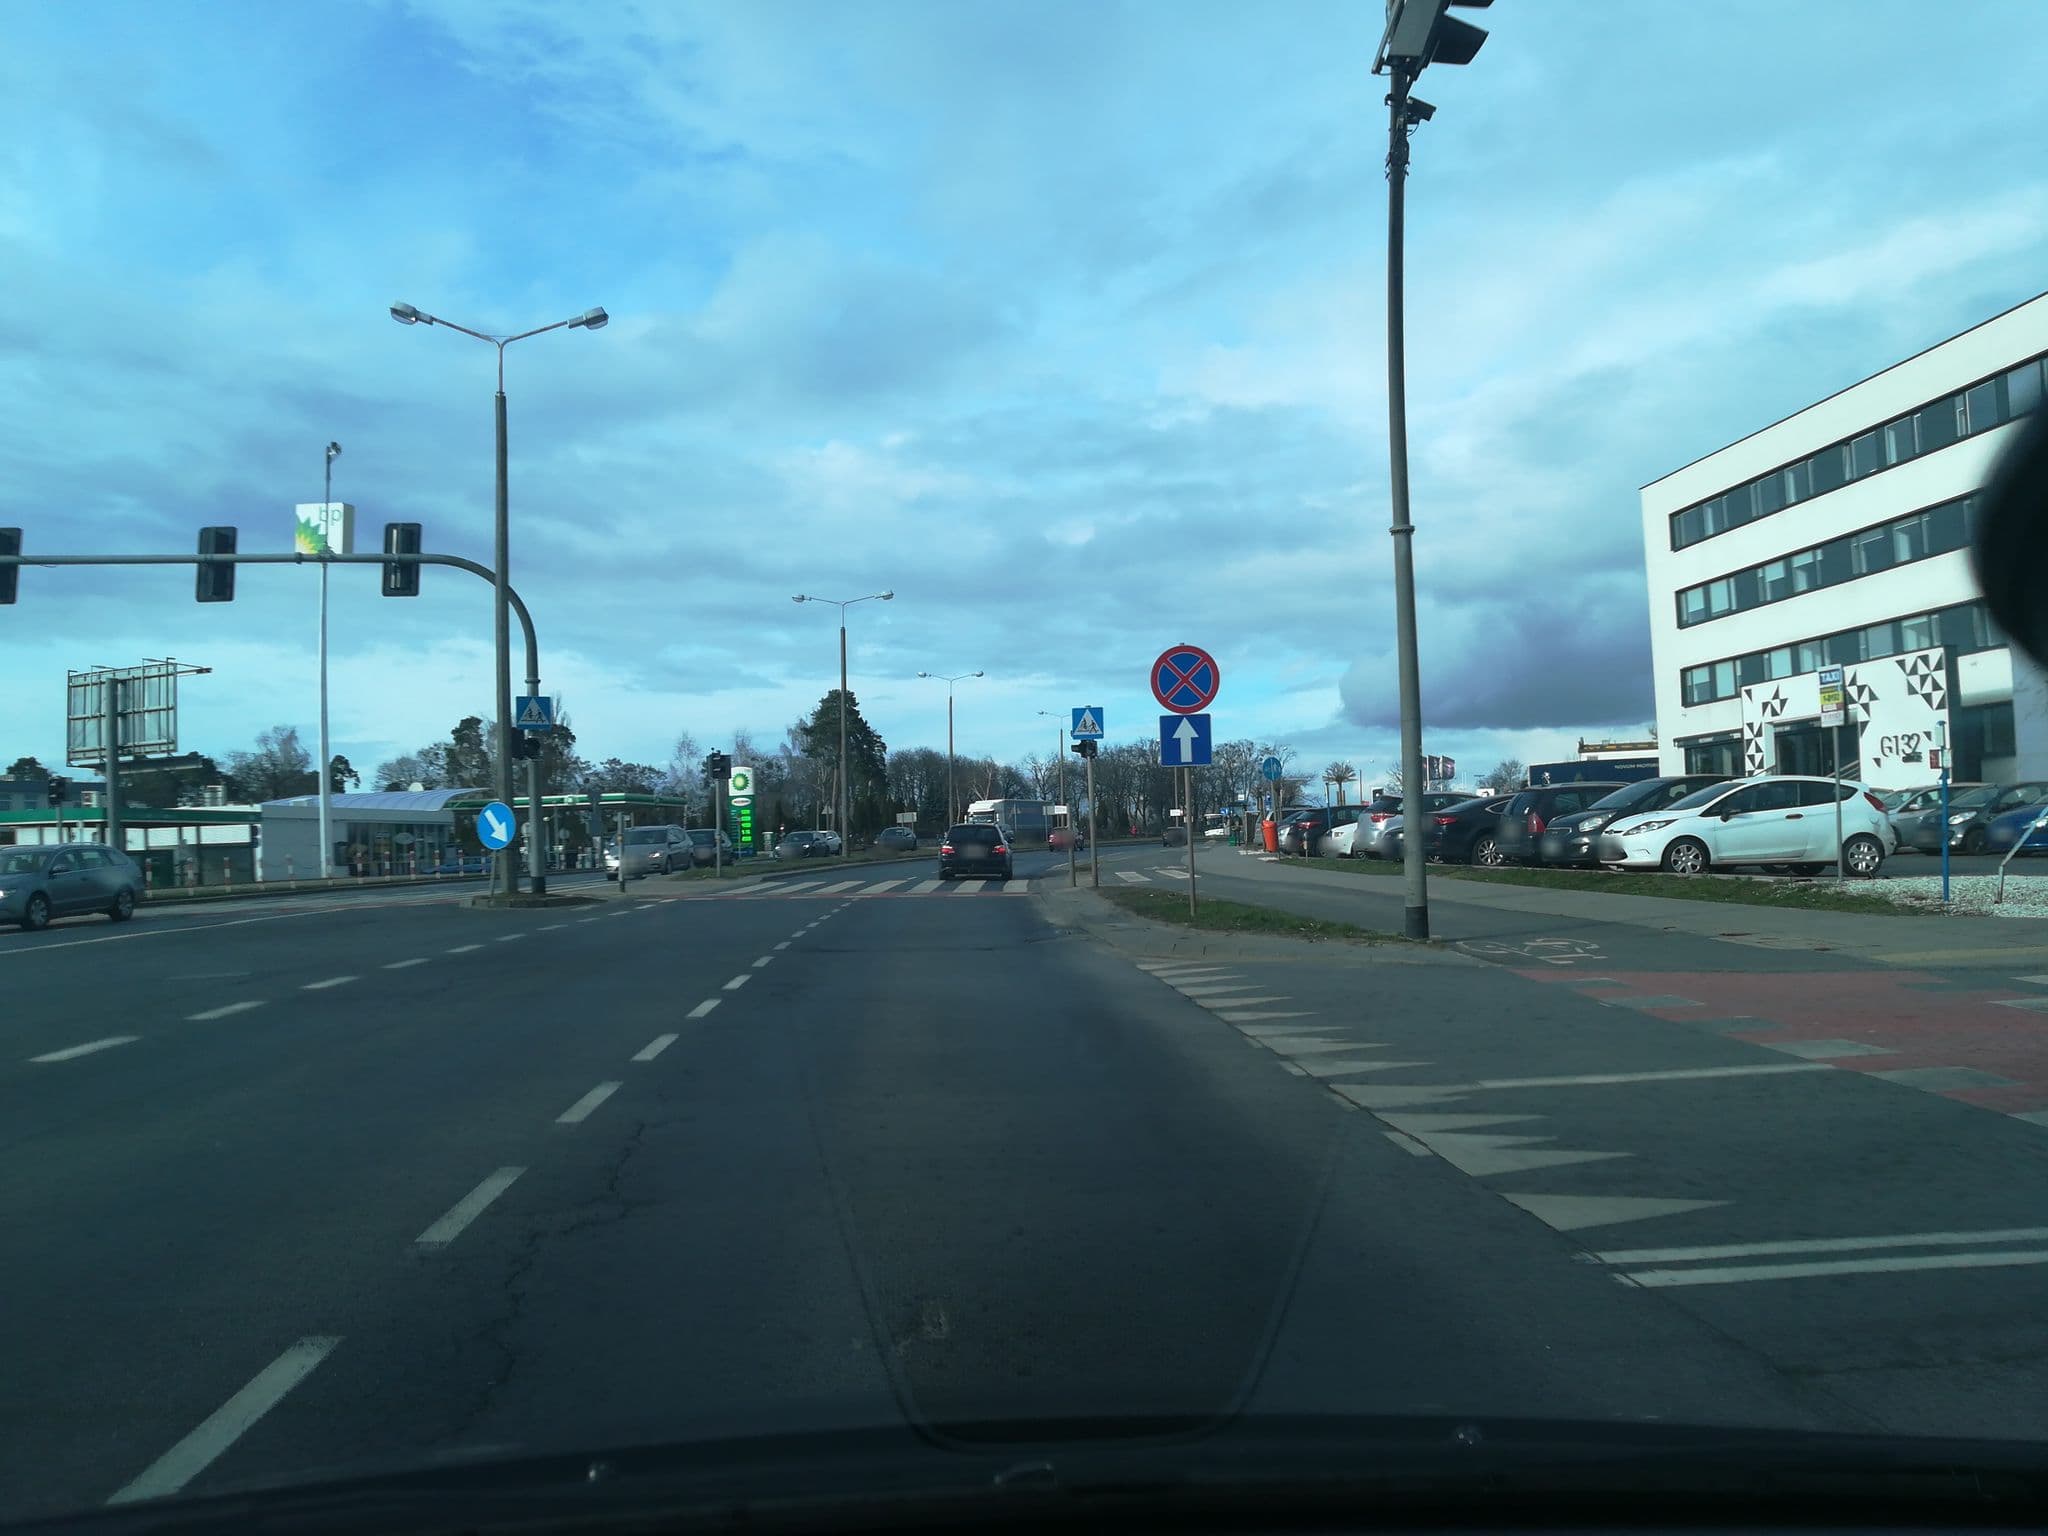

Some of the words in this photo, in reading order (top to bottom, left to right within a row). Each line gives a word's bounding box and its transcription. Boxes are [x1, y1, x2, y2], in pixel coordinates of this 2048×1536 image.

[319, 505, 341, 526] bp
[1820, 670, 1841, 683] TAXI
[1880, 733, 1922, 757] G132
